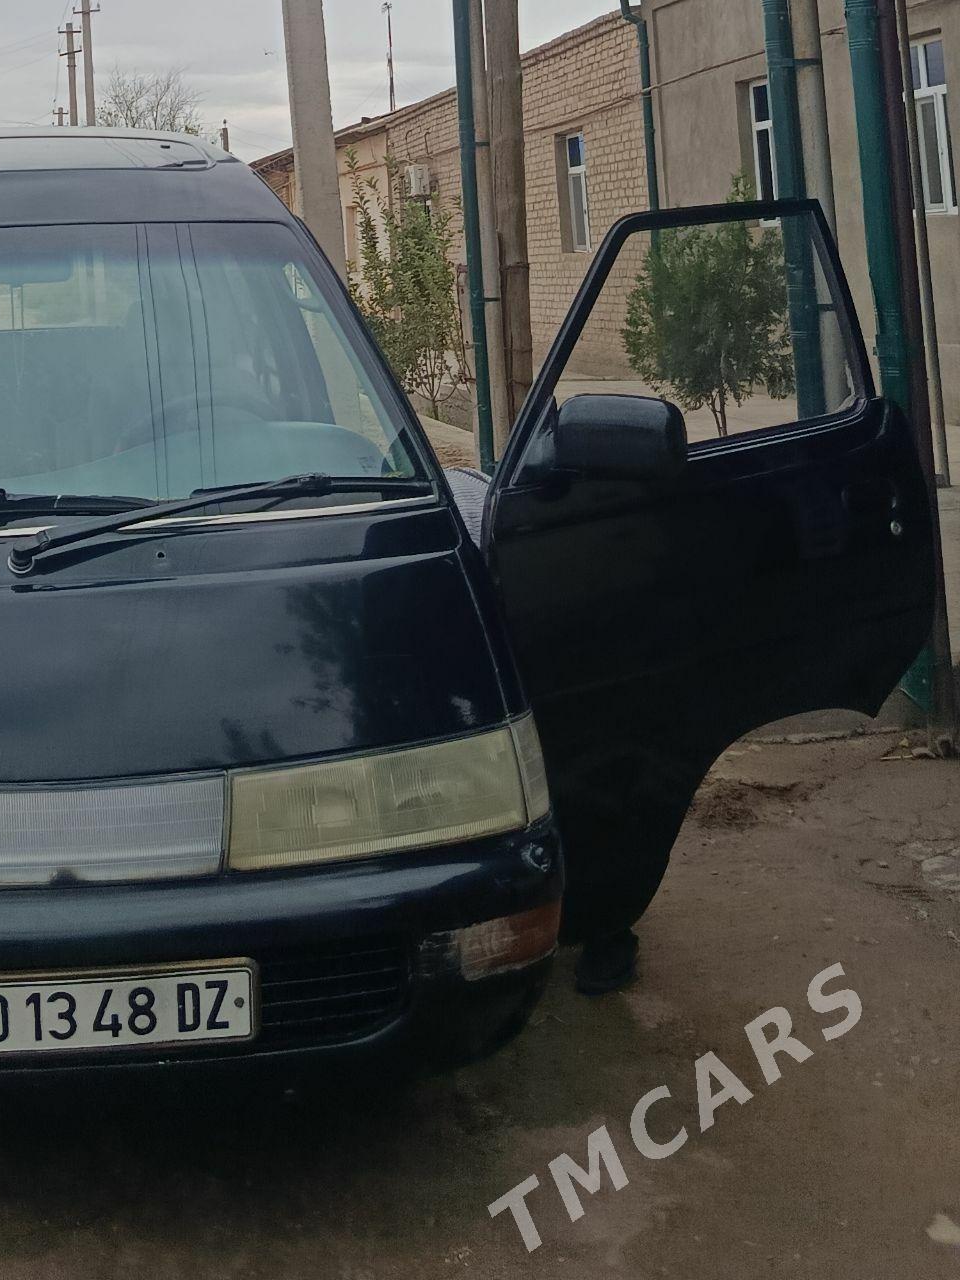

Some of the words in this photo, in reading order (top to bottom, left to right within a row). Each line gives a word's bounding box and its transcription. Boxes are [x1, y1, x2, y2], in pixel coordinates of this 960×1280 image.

[26, 992, 77, 1041] 13
[93, 987, 157, 1037] 48
[177, 980, 229, 1032] DZ
